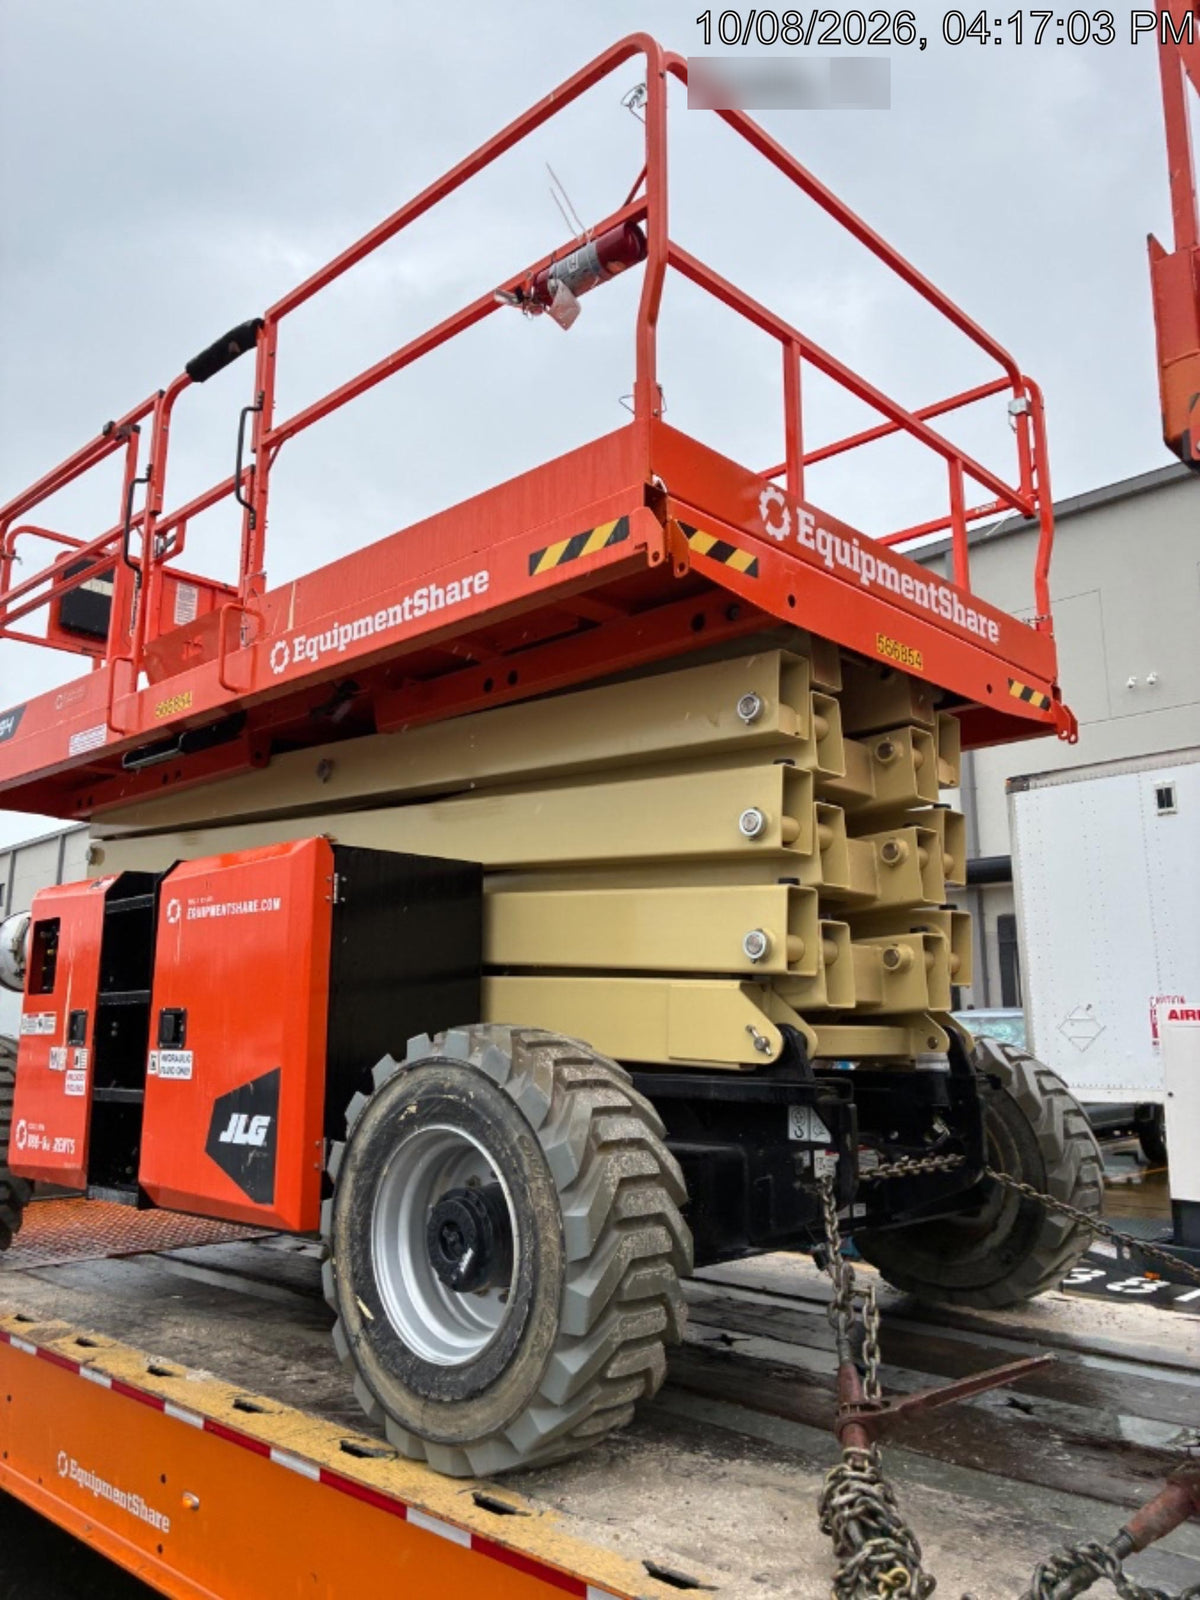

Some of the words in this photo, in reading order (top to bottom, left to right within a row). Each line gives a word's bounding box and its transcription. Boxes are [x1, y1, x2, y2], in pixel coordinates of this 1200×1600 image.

[795, 506, 1000, 645] EquipmentShare
[292, 569, 490, 664] EquipmentShare
[877, 633, 923, 669] 566854
[218, 1112, 271, 1147] JLG
[69, 1457, 171, 1534] EquipmentShare
